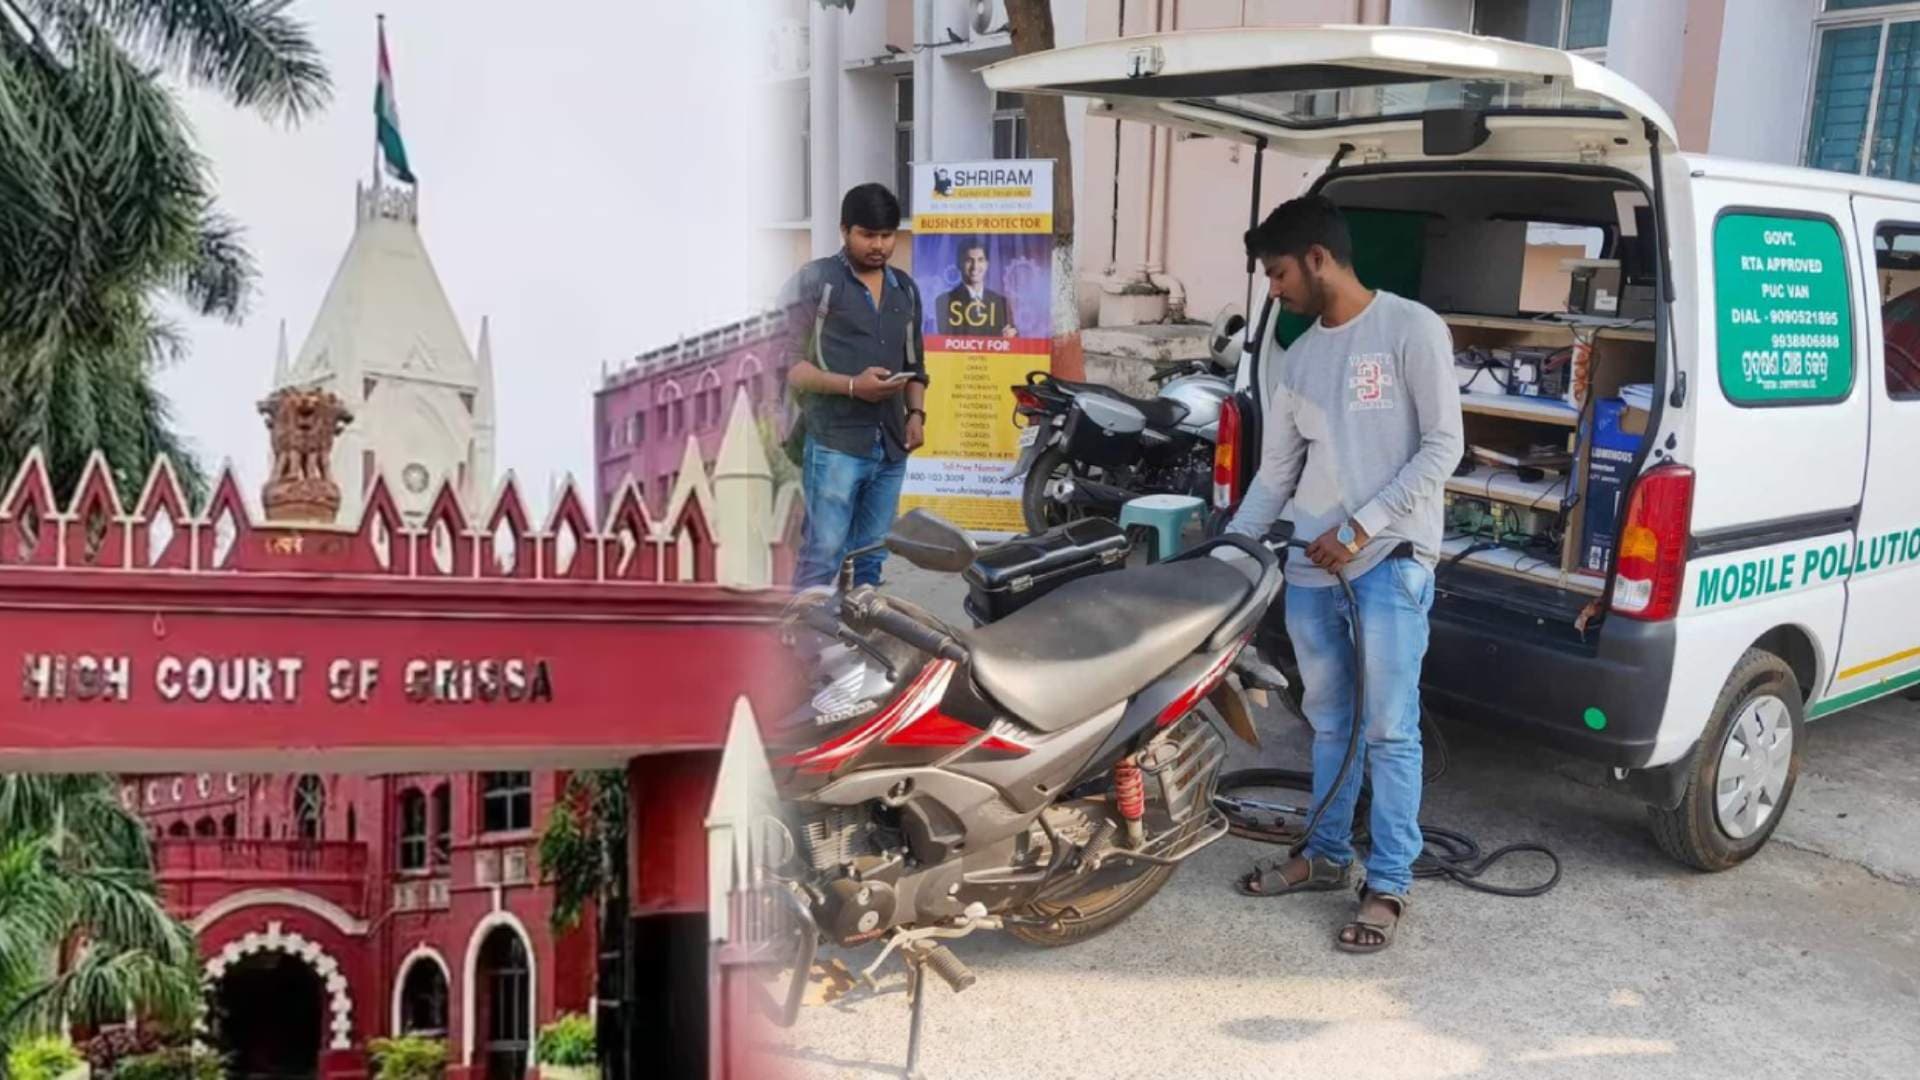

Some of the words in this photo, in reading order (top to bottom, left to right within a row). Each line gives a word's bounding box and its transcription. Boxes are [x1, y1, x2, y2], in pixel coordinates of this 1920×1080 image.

[954, 169, 1033, 186] SHRIRAM
[920, 217, 973, 229] BUSINESS
[976, 217, 1041, 229] PROTECTOR
[1763, 230, 1796, 246] GOVT.
[1741, 256, 1764, 271] RTA
[1766, 258, 1823, 273] APPROVED
[1761, 284, 1784, 298] PUC
[1787, 285, 1810, 299] VAN
[949, 301, 996, 327] SGI
[1731, 308, 1761, 324] DIAL
[945, 339, 984, 350] POLICY
[988, 340, 1010, 351] FOR
[1357, 360, 1382, 403] 3
[1696, 555, 1795, 607] MOBILE
[22, 654, 130, 702] HIGH
[155, 656, 302, 702] COURT
[816, 699, 878, 726] HONDA
